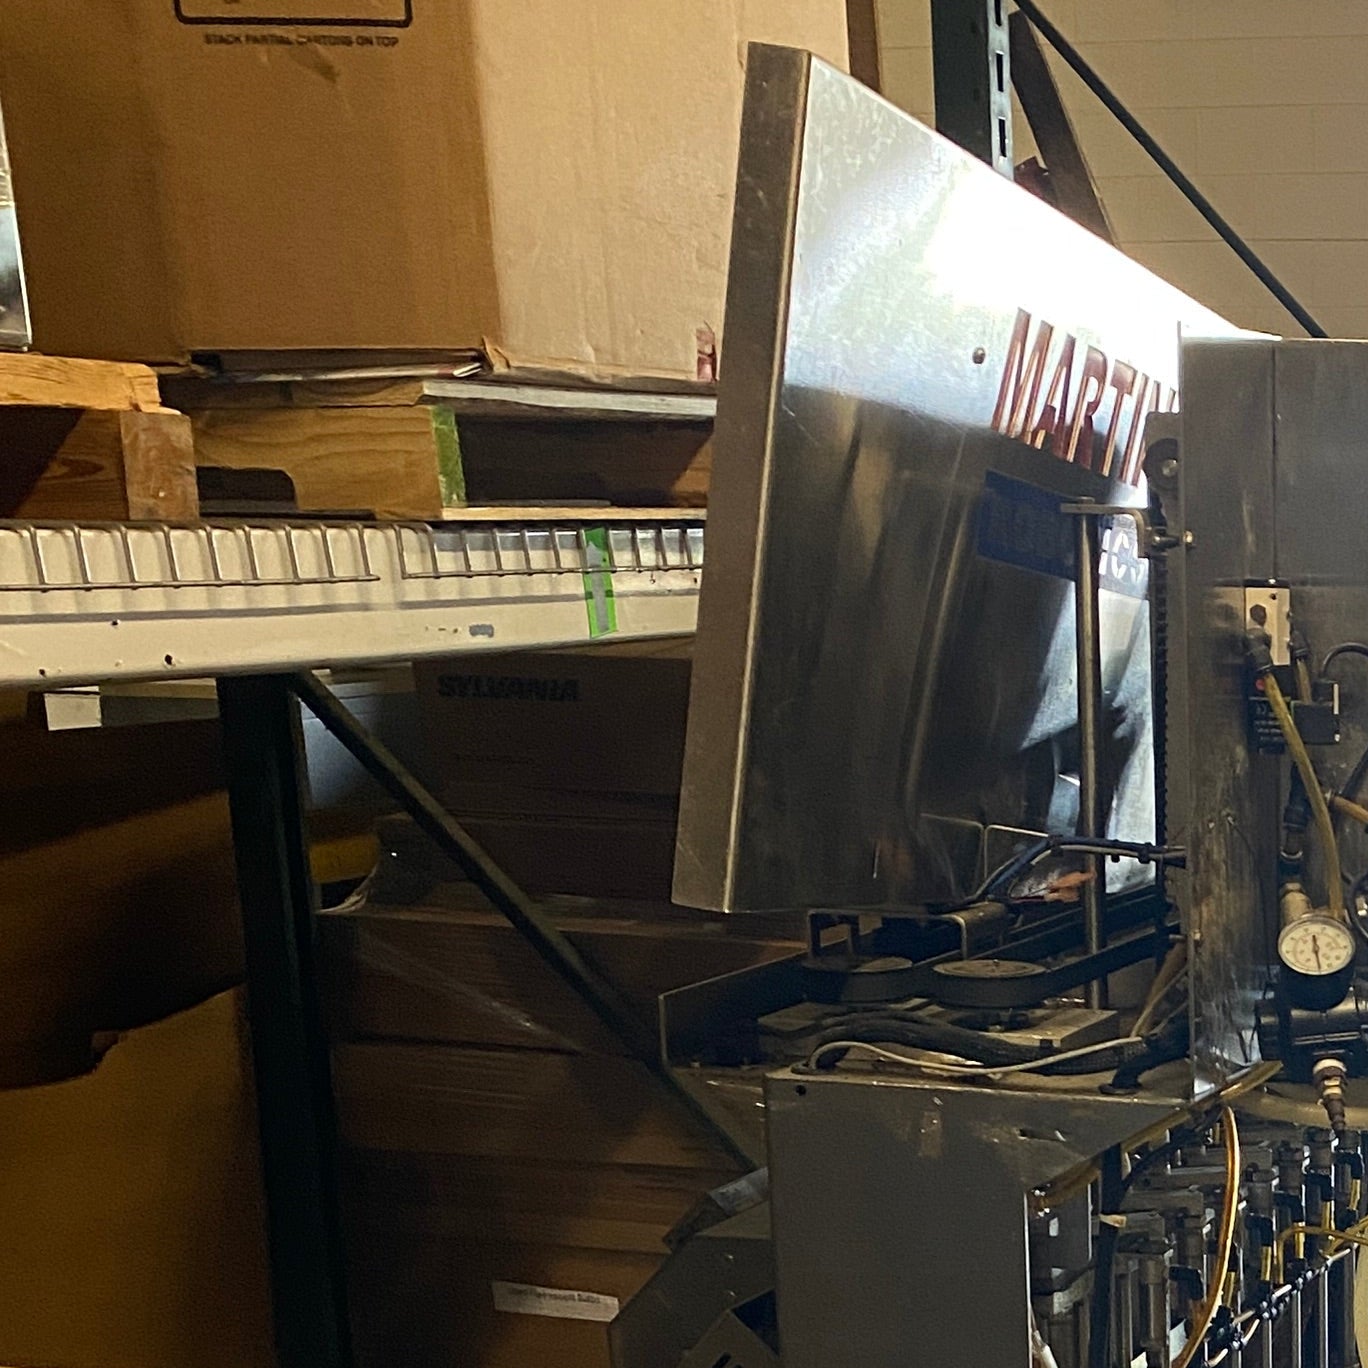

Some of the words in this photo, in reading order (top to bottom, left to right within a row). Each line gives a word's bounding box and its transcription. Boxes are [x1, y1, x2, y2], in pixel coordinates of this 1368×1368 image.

[204, 34, 242, 44] STACK
[245, 34, 293, 46] PARTIAL
[356, 35, 374, 46] ON
[376, 36, 399, 47] TOP
[437, 674, 579, 702] SYLVANIA
